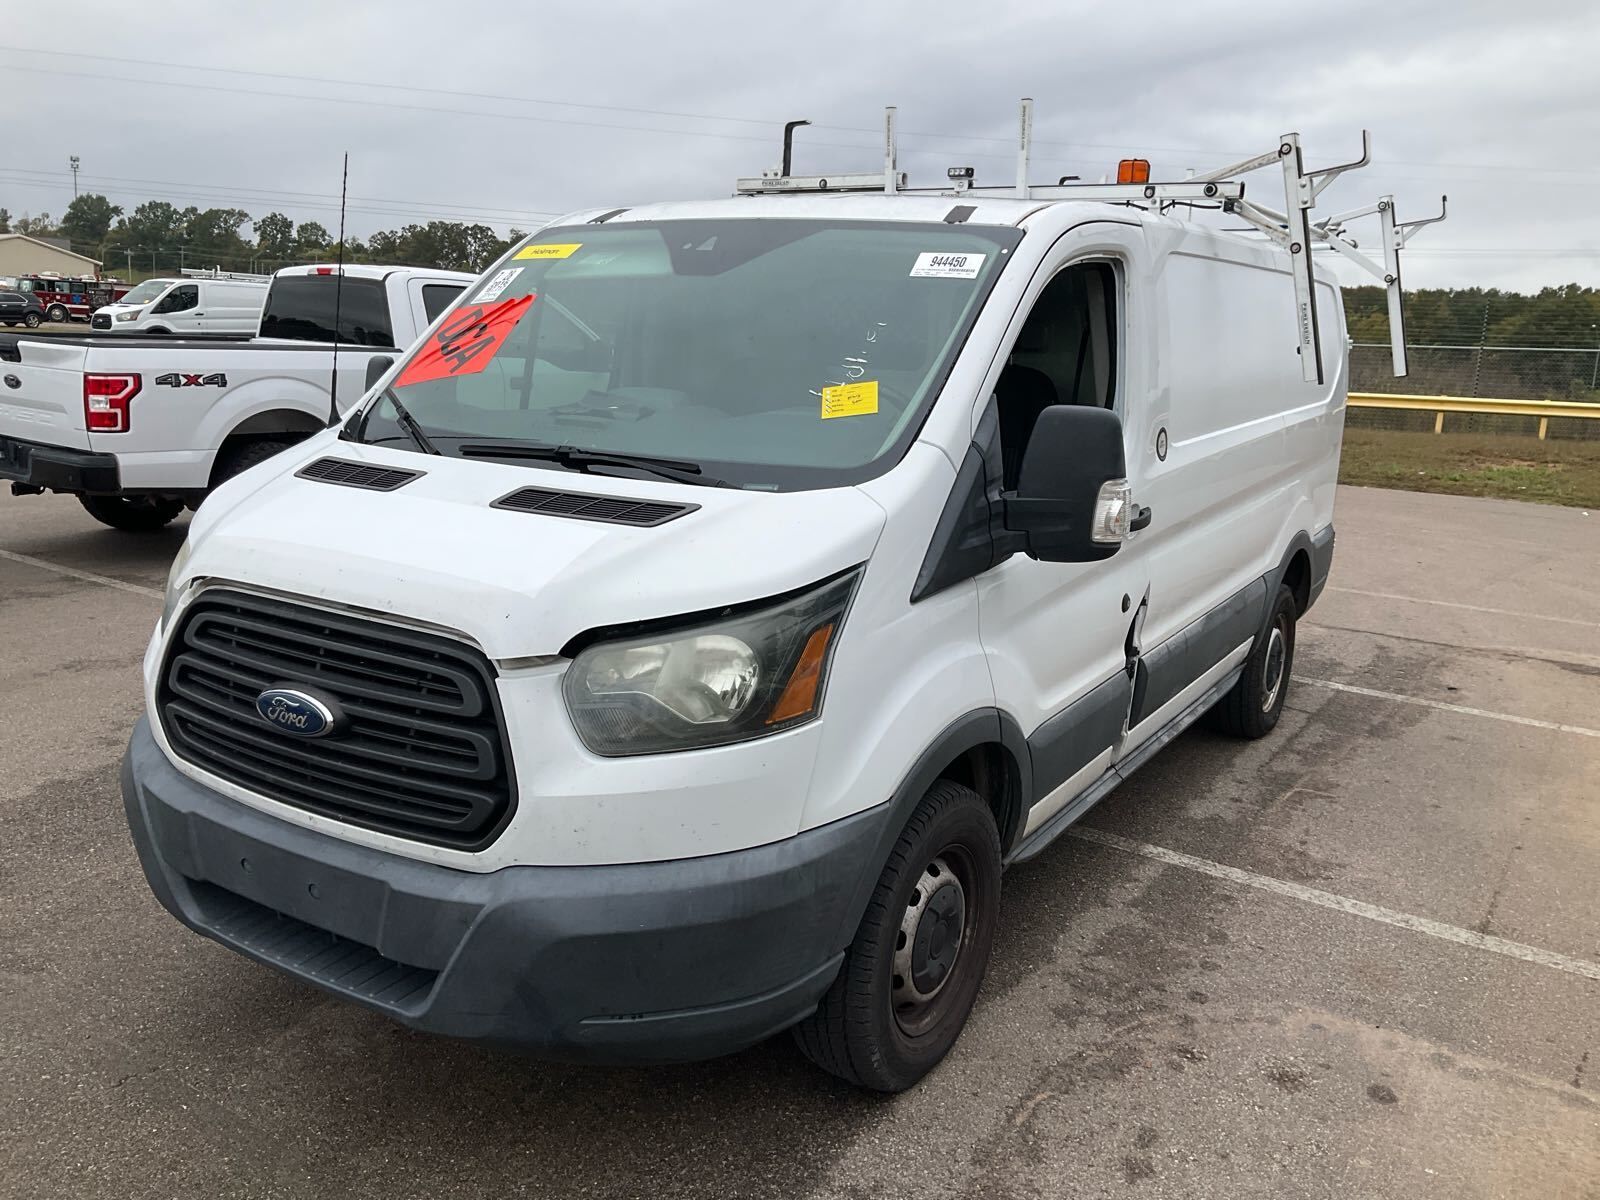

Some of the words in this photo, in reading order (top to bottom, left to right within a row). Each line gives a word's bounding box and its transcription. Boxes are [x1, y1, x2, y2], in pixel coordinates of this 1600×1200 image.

[930, 256, 967, 268] 944450
[437, 307, 496, 374] DCA
[267, 696, 309, 729] Ford
